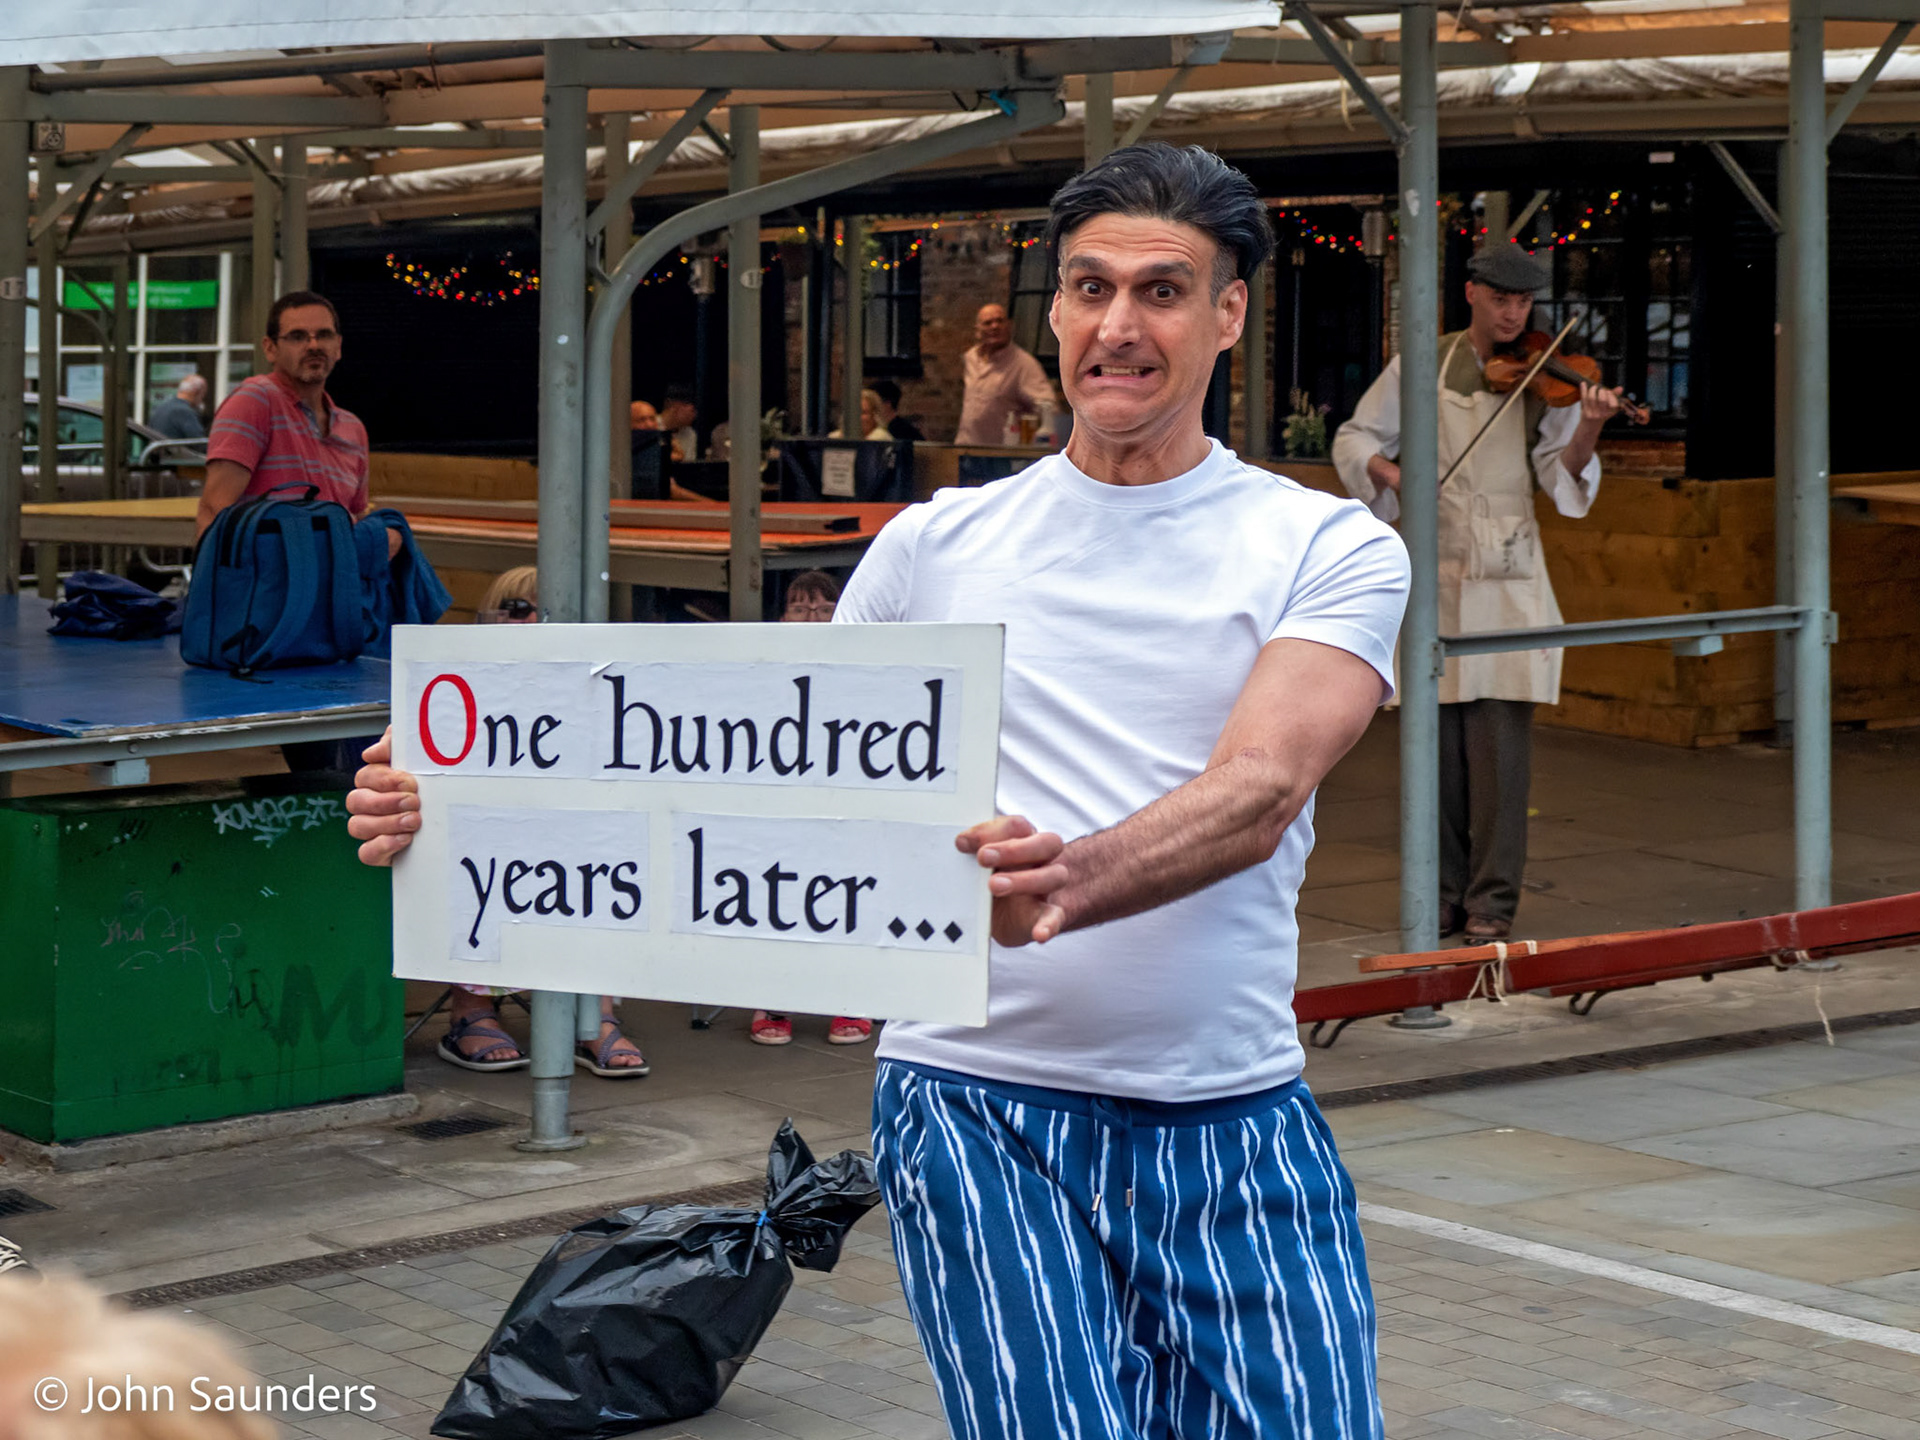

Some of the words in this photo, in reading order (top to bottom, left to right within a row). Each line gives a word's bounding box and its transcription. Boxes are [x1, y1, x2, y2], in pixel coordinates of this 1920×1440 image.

[418, 673, 562, 770] One
[602, 674, 945, 782] hundred
[460, 856, 642, 949] years
[687, 827, 963, 945] later...
